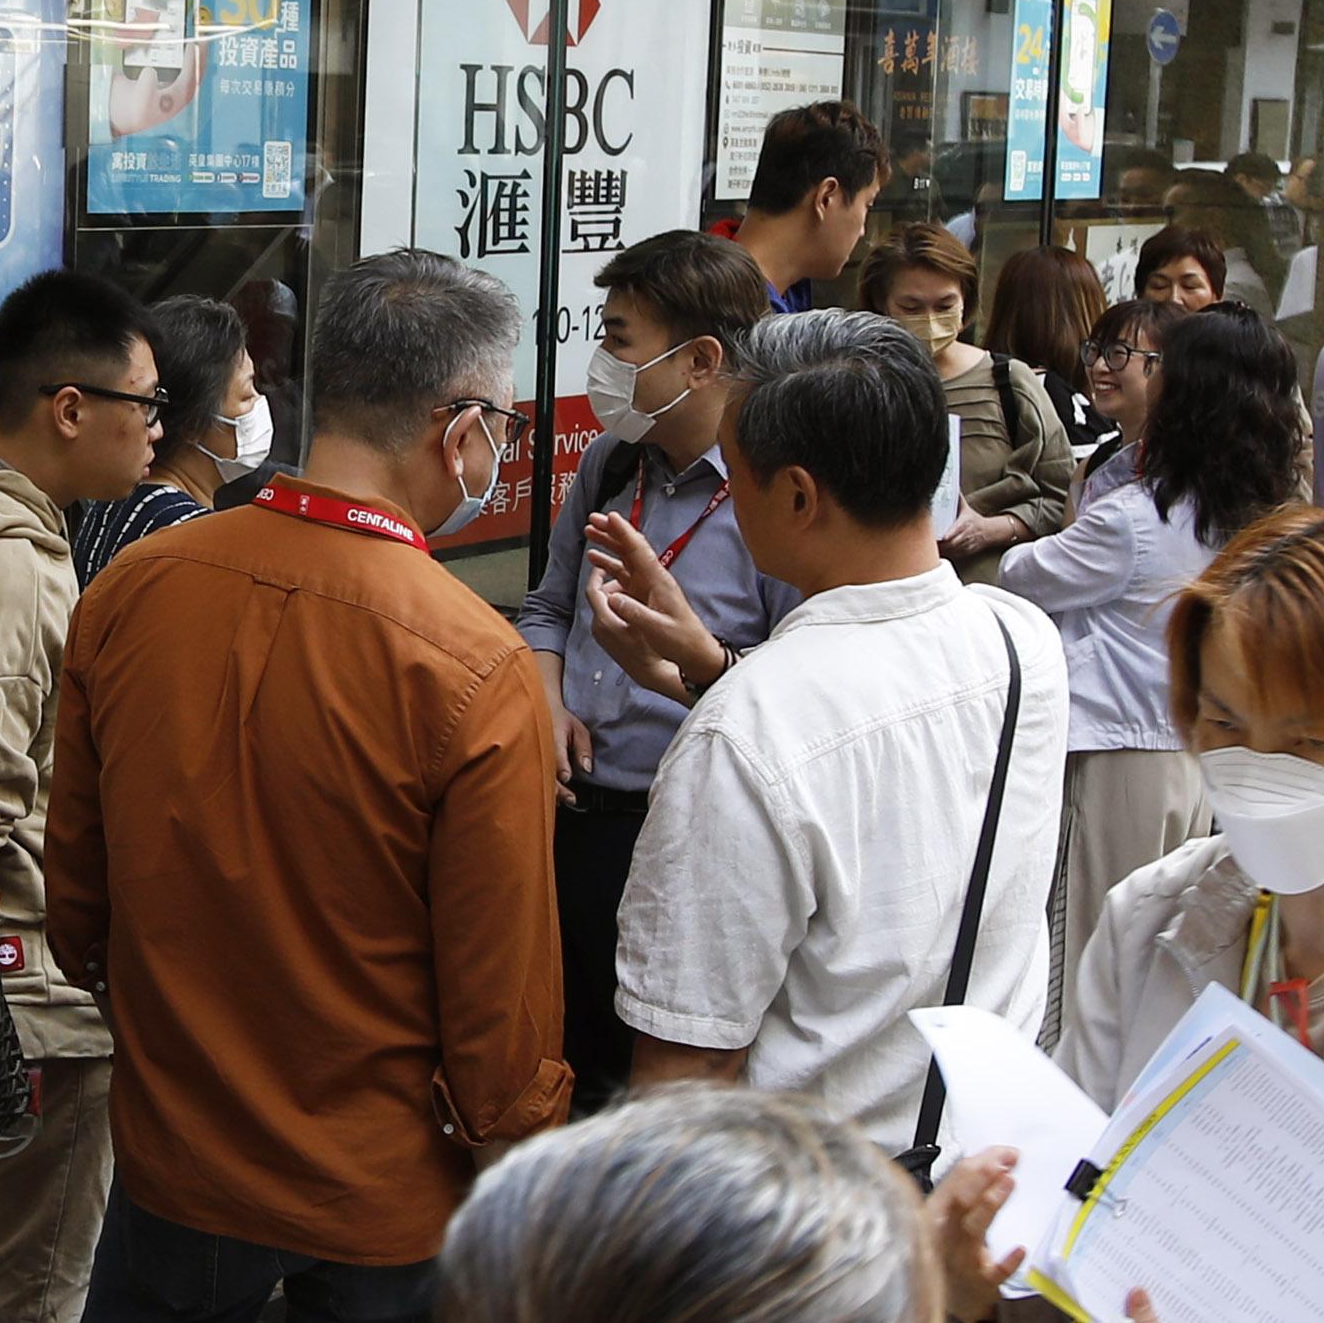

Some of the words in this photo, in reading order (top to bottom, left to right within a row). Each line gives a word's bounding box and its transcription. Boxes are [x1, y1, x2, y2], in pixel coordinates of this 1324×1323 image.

[218, 35, 298, 70] 投資產品
[457, 63, 635, 157] HSBC
[527, 422, 598, 461] Srvice
[347, 508, 414, 542] CENTALINE
